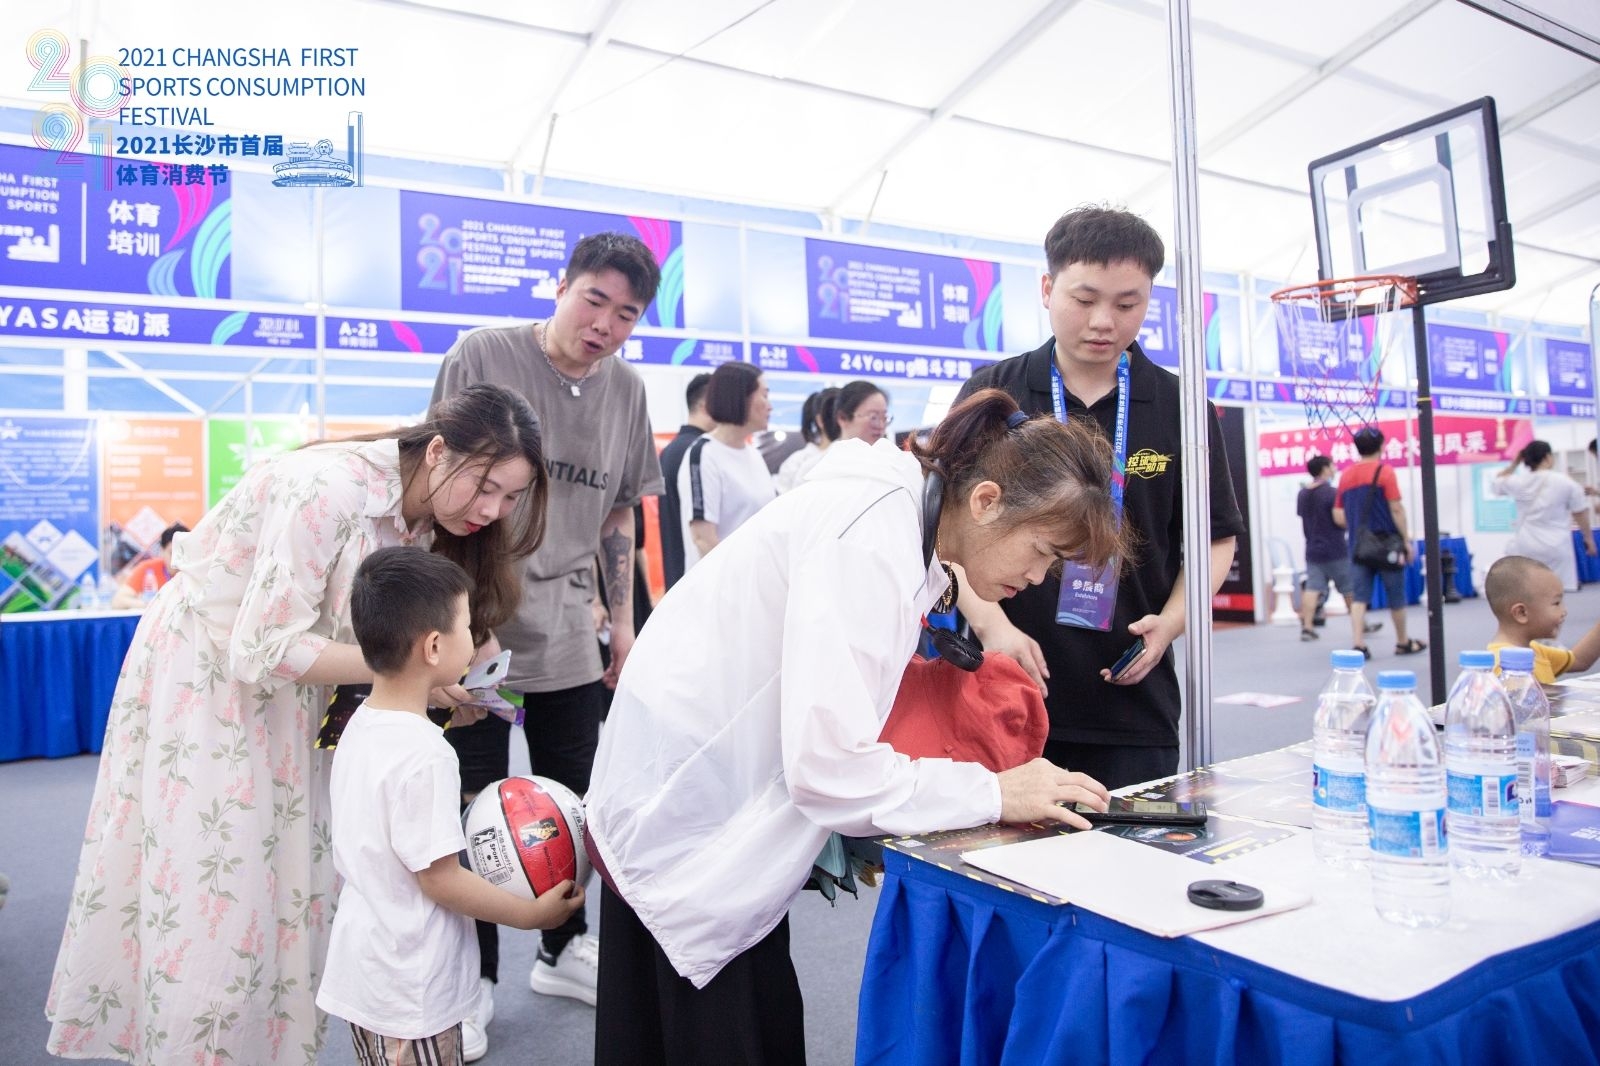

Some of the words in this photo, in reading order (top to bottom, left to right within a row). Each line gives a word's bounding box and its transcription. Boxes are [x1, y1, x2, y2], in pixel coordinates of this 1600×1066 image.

[22, 174, 59, 189] FIRST
[6, 199, 58, 215] SPORTS
[107, 198, 161, 228] 体育
[107, 229, 161, 258] 培训
[338, 320, 378, 337] A-23
